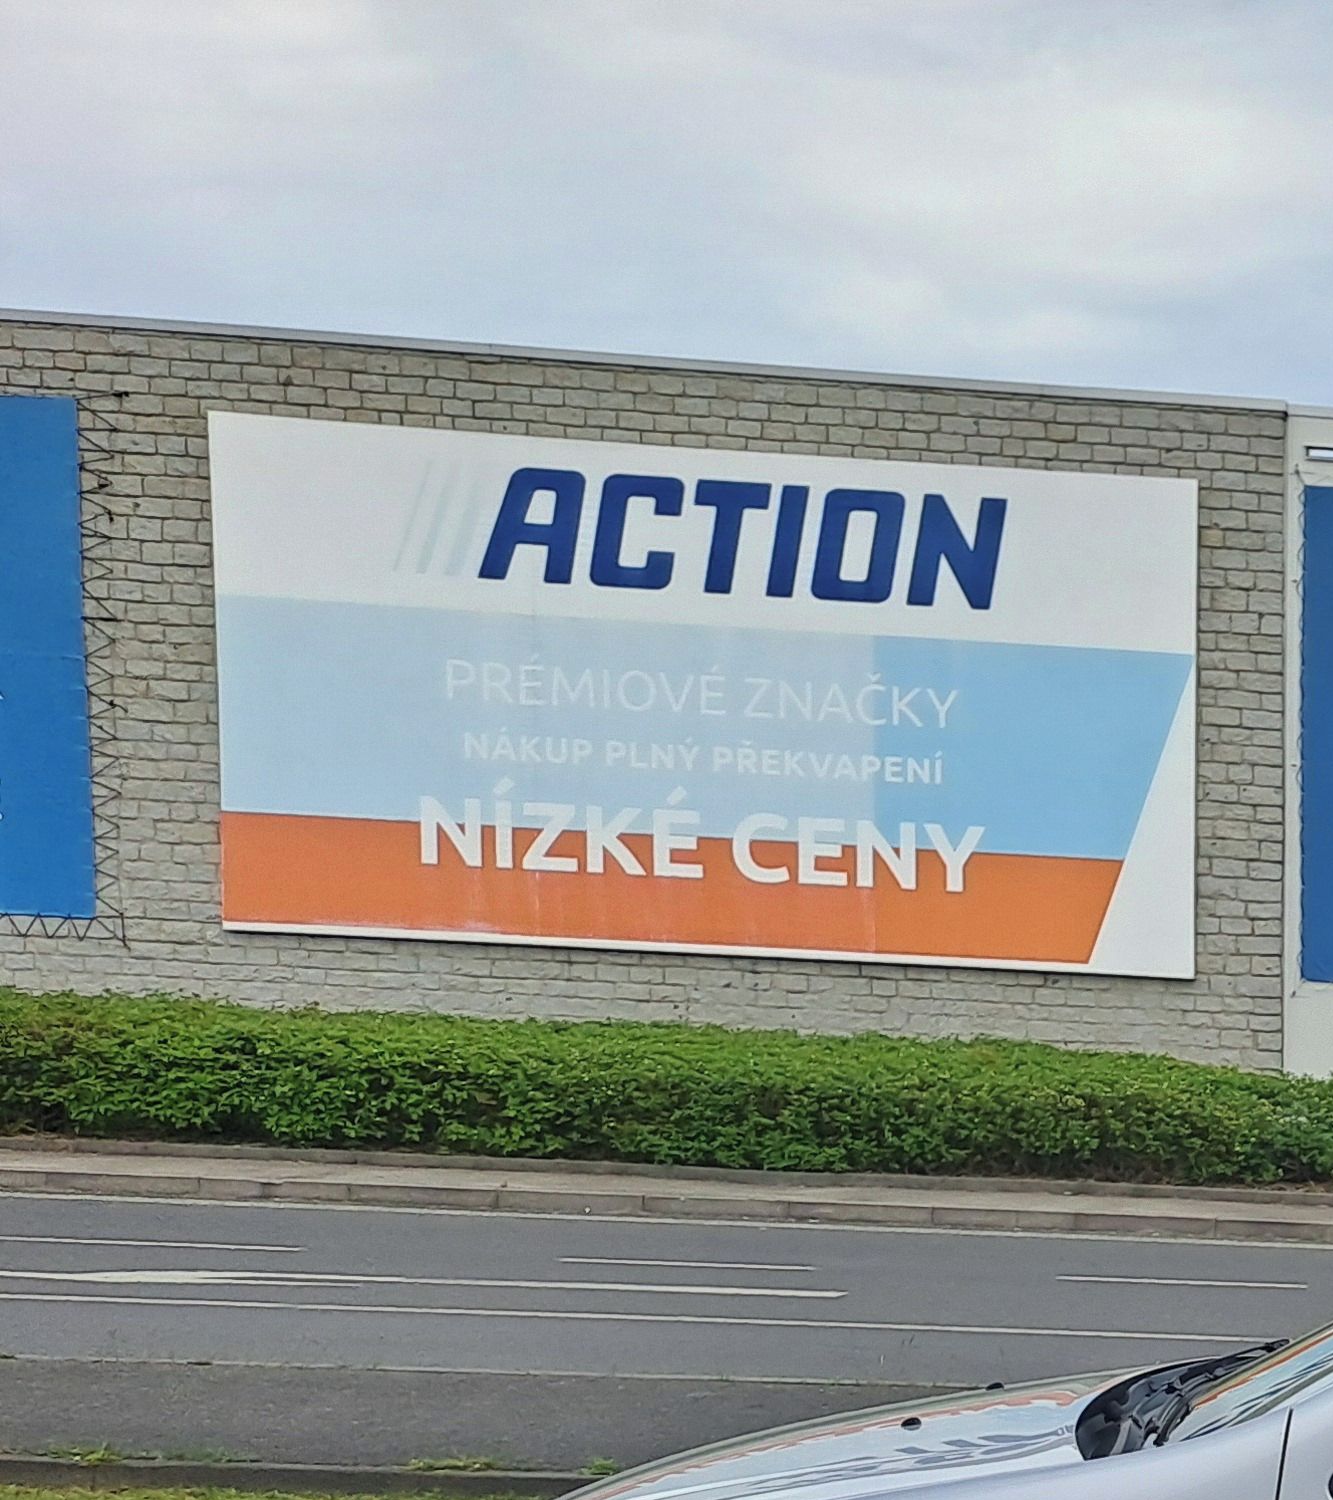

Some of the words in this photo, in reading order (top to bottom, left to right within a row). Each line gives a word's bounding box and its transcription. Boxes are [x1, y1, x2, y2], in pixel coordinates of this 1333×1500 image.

[478, 466, 1008, 610] ACTION
[445, 655, 726, 716] PRÉMIOVÉ
[744, 673, 958, 728] ZNAČKY
[463, 728, 593, 765] NÁKUP
[605, 737, 699, 771] PLNÝ
[713, 739, 943, 785] PŘEKVAPENÍ
[420, 776, 704, 879] NÍZKÉ
[732, 812, 986, 892] CENY
